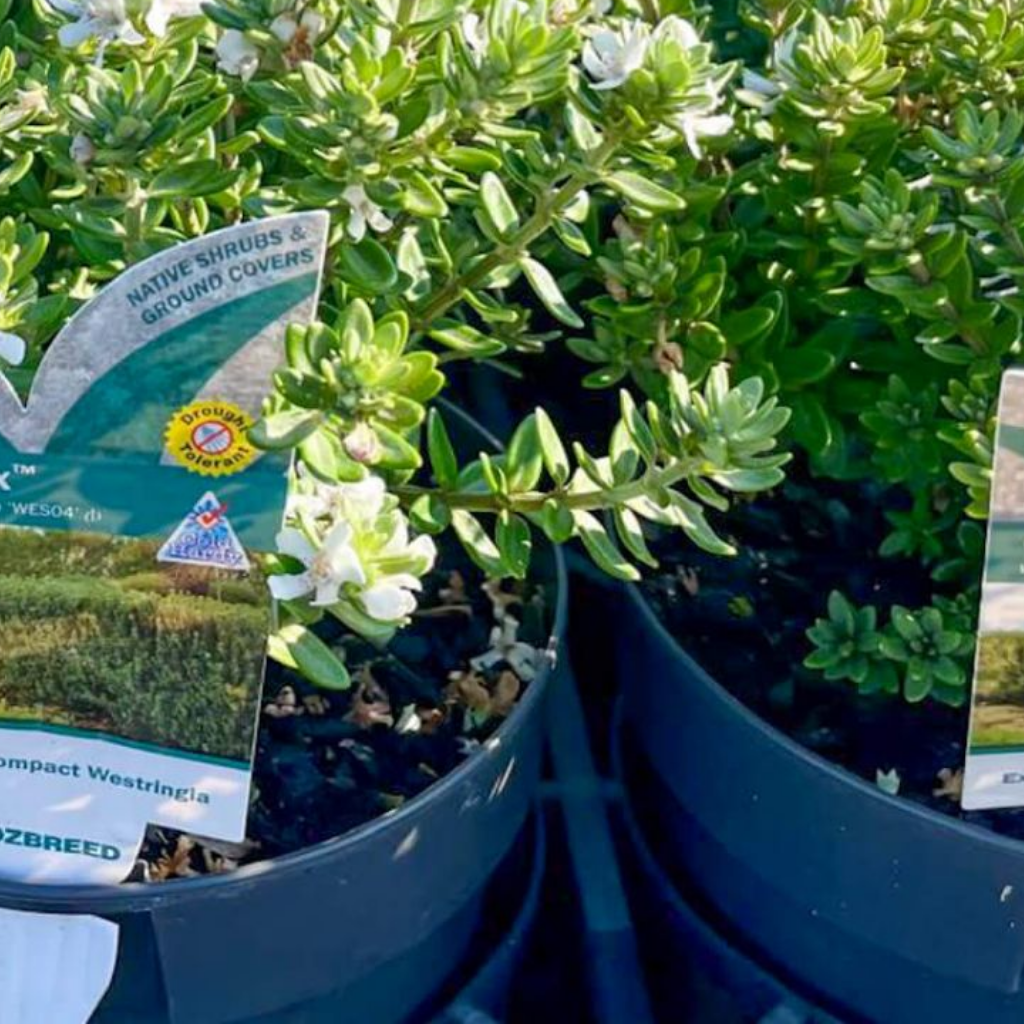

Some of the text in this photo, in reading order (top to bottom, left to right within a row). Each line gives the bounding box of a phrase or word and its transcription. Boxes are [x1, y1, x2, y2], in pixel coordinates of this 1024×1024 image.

[127, 227, 308, 307] NATIVE SHRUBS &
[140, 247, 315, 325] GROUND COVERS
[180, 407, 249, 433] Drought
[179, 442, 250, 469] Tolerant
[86, 764, 211, 805] Westringia
